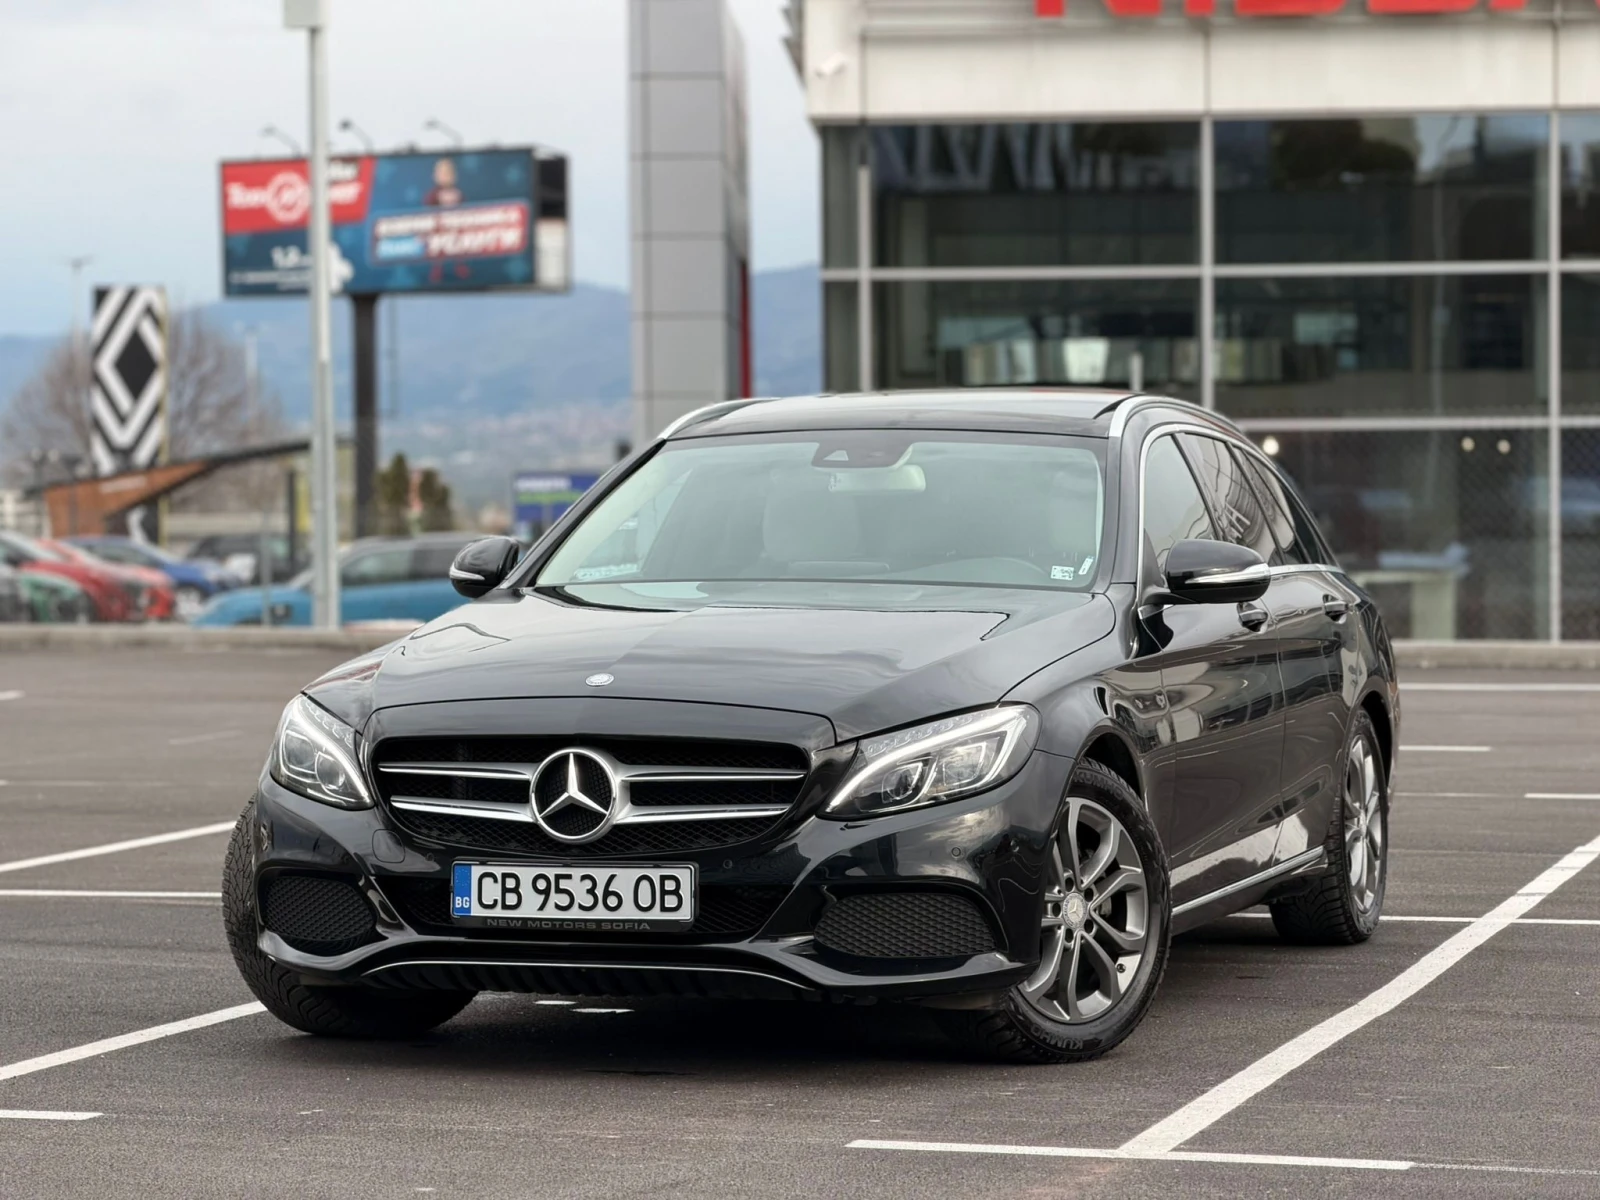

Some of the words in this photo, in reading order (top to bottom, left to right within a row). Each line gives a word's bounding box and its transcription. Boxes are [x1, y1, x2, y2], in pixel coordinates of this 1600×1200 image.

[1073, 770, 1124, 801] KUMHO
[455, 896, 470, 909] BG
[477, 872, 523, 911] CB
[531, 872, 624, 912] 9536
[632, 873, 684, 913] OB
[486, 918, 522, 928] NEW
[527, 920, 597, 930] MOTORS
[601, 922, 651, 931] SOFIA
[1030, 1023, 1084, 1050] KUMHO
